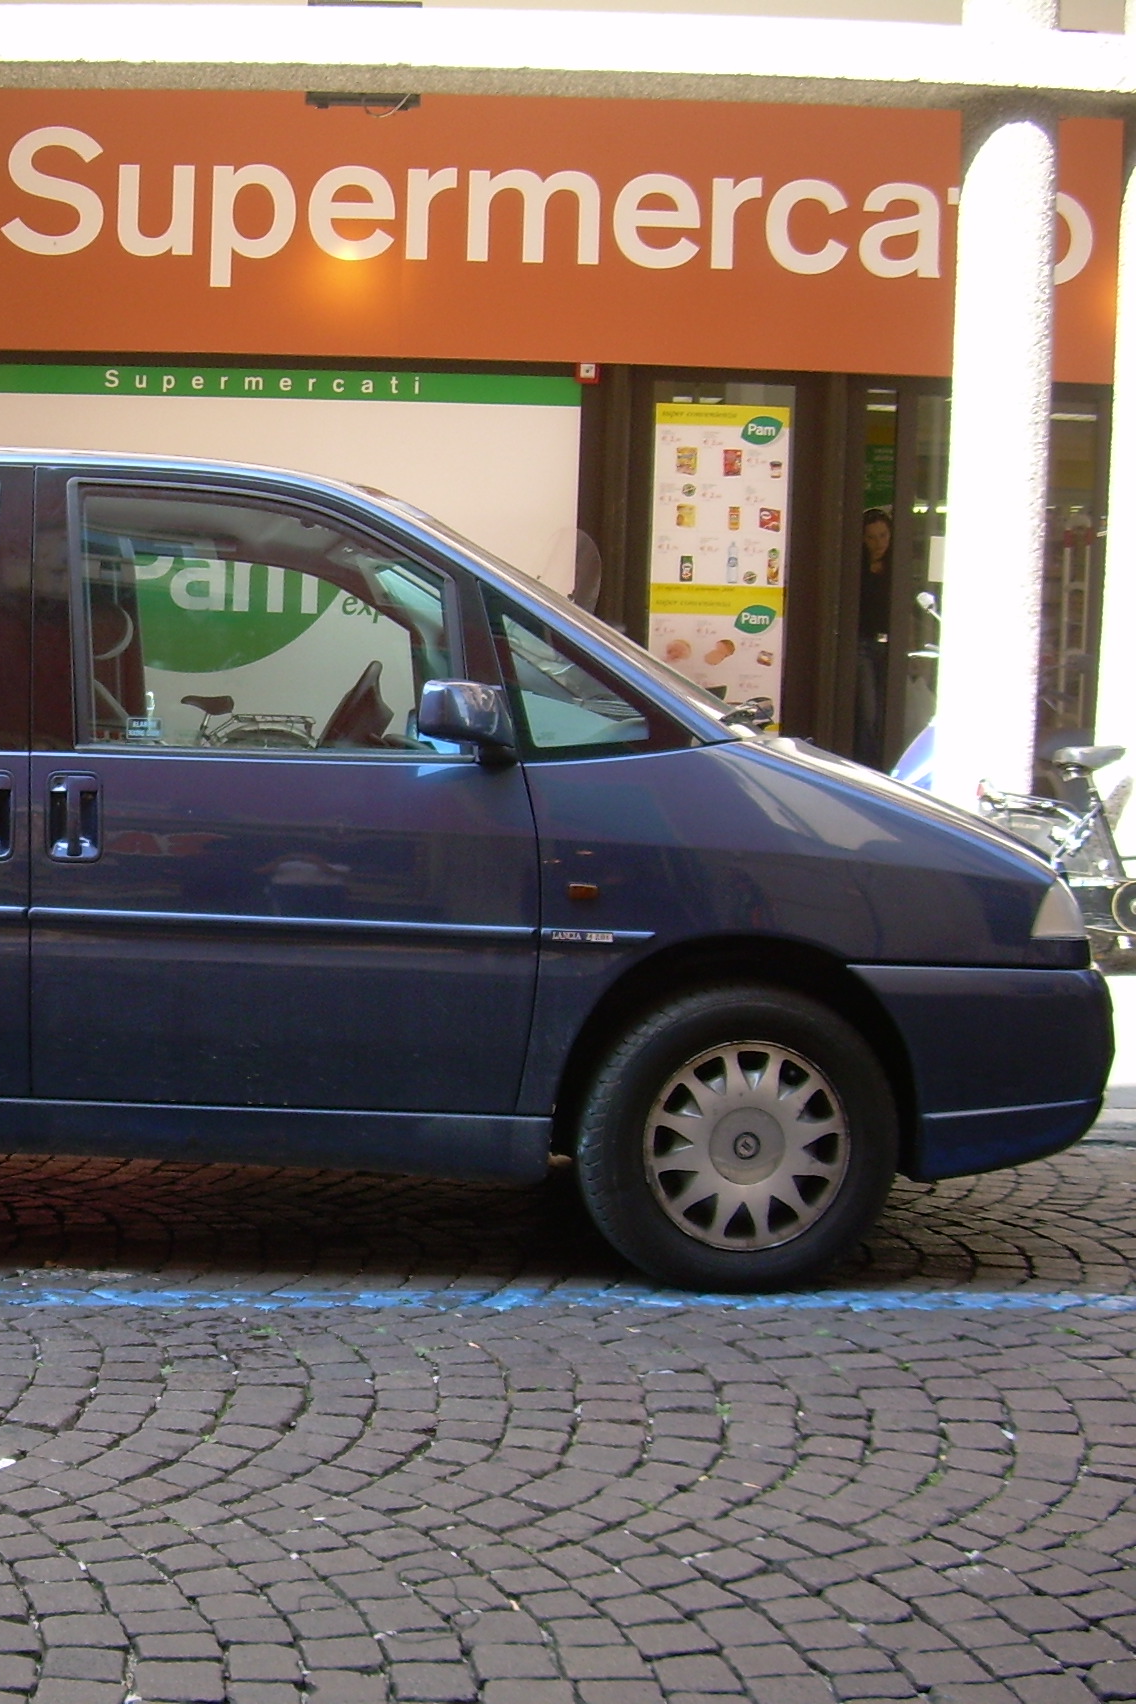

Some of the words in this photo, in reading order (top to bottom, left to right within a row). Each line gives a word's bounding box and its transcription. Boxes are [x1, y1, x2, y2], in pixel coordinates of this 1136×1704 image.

[0, 126, 1093, 287] Supermerca
[104, 368, 420, 394] Supermercati
[748, 424, 776, 436] Pam
[741, 612, 769, 625] Pam
